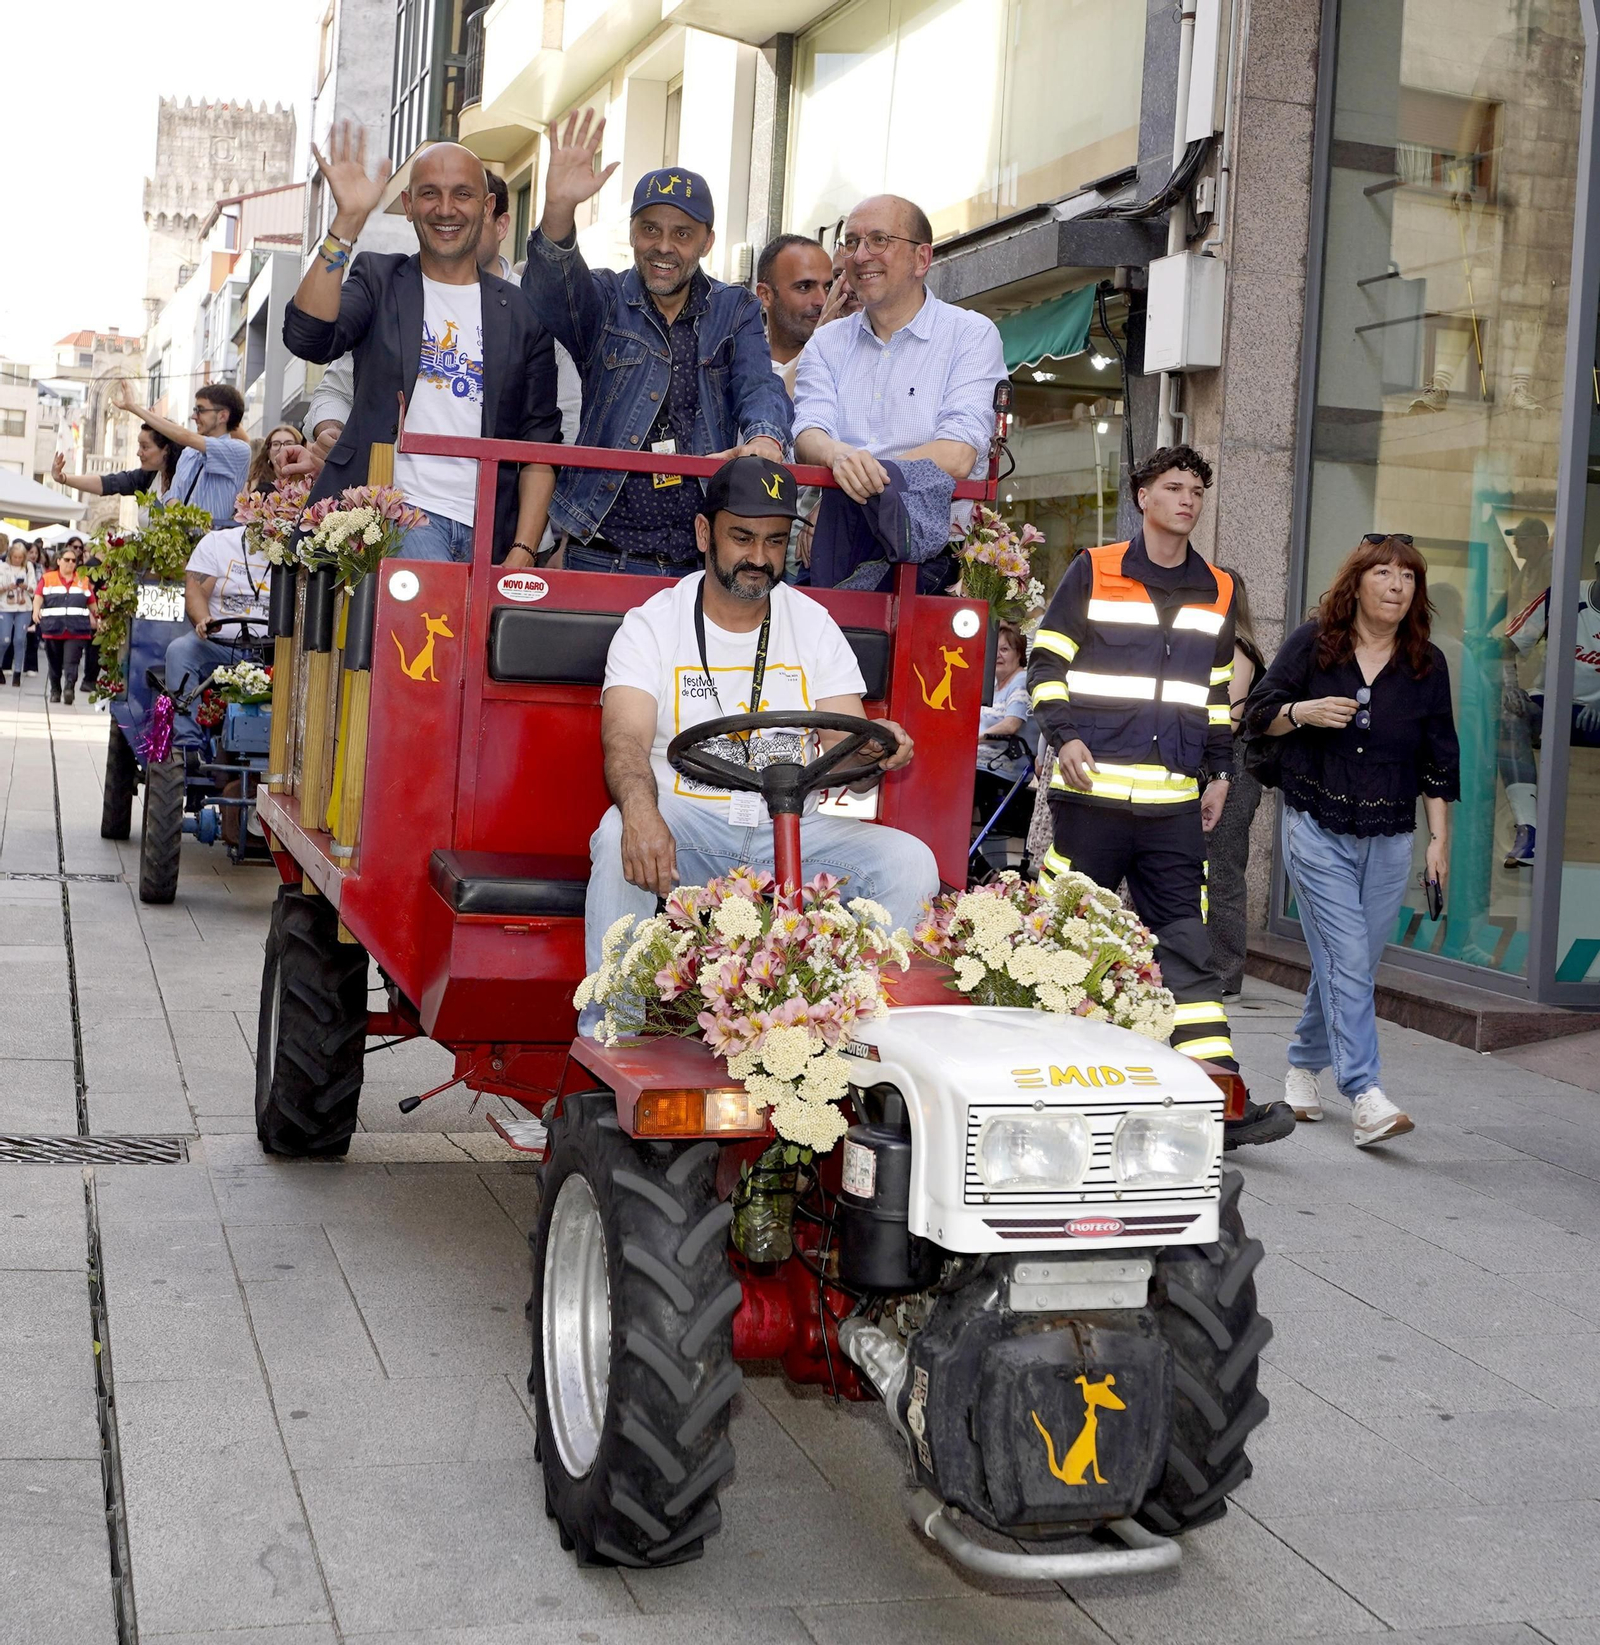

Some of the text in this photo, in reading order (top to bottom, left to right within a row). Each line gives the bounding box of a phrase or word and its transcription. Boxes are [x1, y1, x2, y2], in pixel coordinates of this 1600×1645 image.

[503, 579, 523, 589] NOVO
[525, 581, 545, 591] AGRO
[683, 674, 715, 688] festival
[681, 687, 719, 700] de cans
[846, 1041, 869, 1058] OTECO
[1049, 1064, 1126, 1088] MID
[1070, 1221, 1120, 1232] ROTECO
